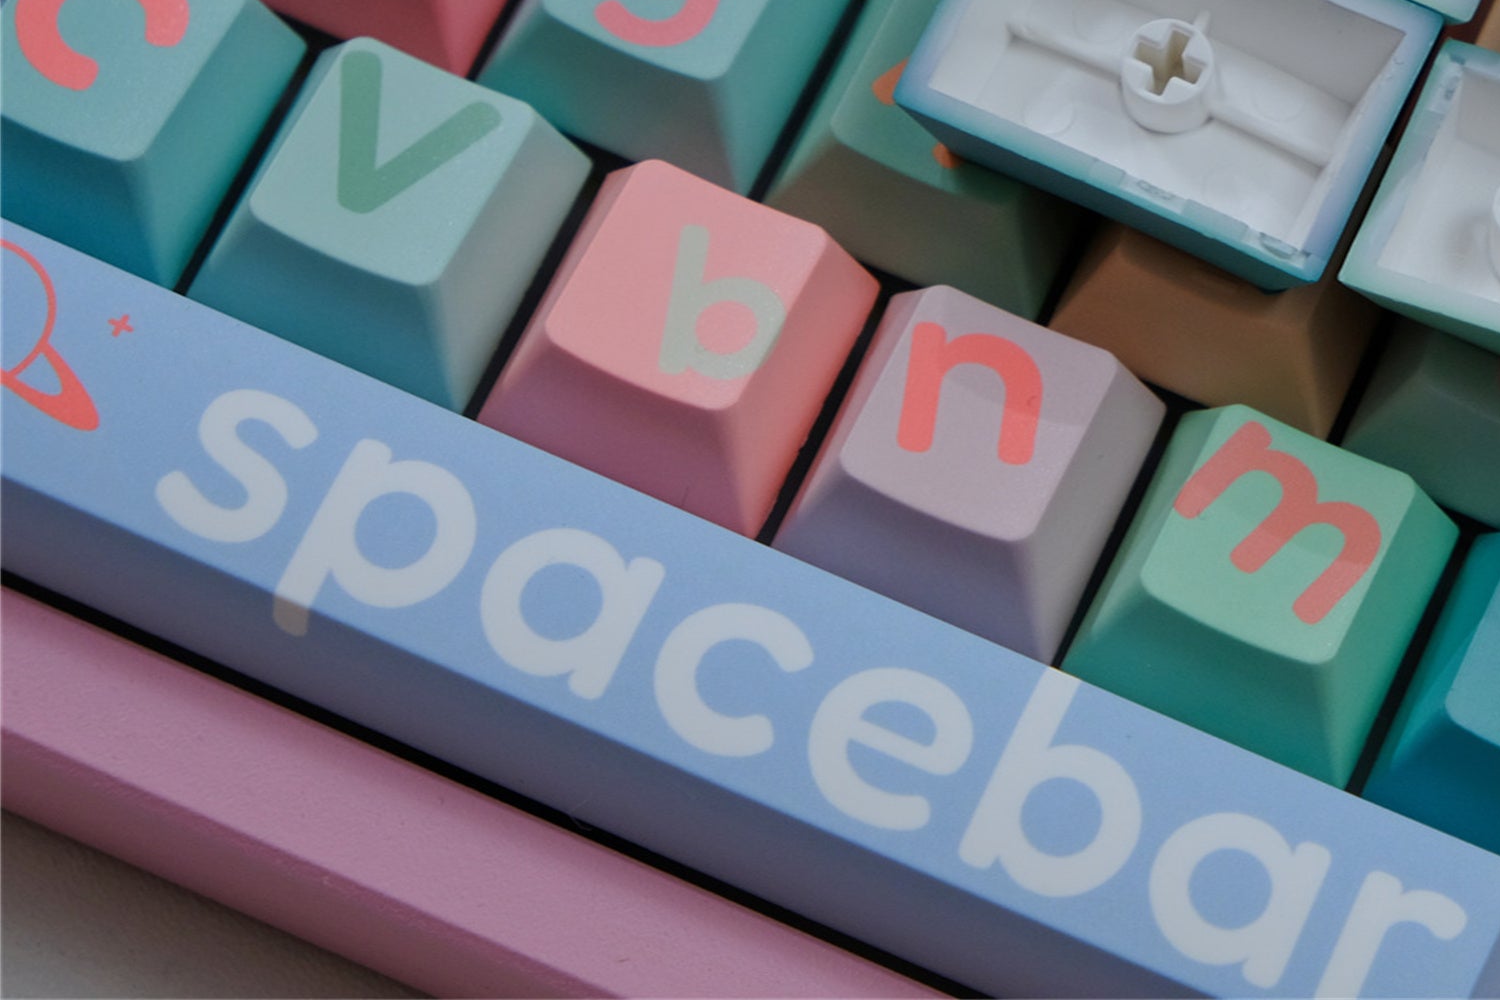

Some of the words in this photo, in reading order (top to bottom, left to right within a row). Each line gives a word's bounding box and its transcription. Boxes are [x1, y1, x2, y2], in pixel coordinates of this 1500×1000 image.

[337, 50, 502, 214] v
[659, 224, 785, 380] b
[897, 321, 1043, 465] n
[1173, 420, 1382, 625] m
[155, 387, 1468, 1000] spacebar
